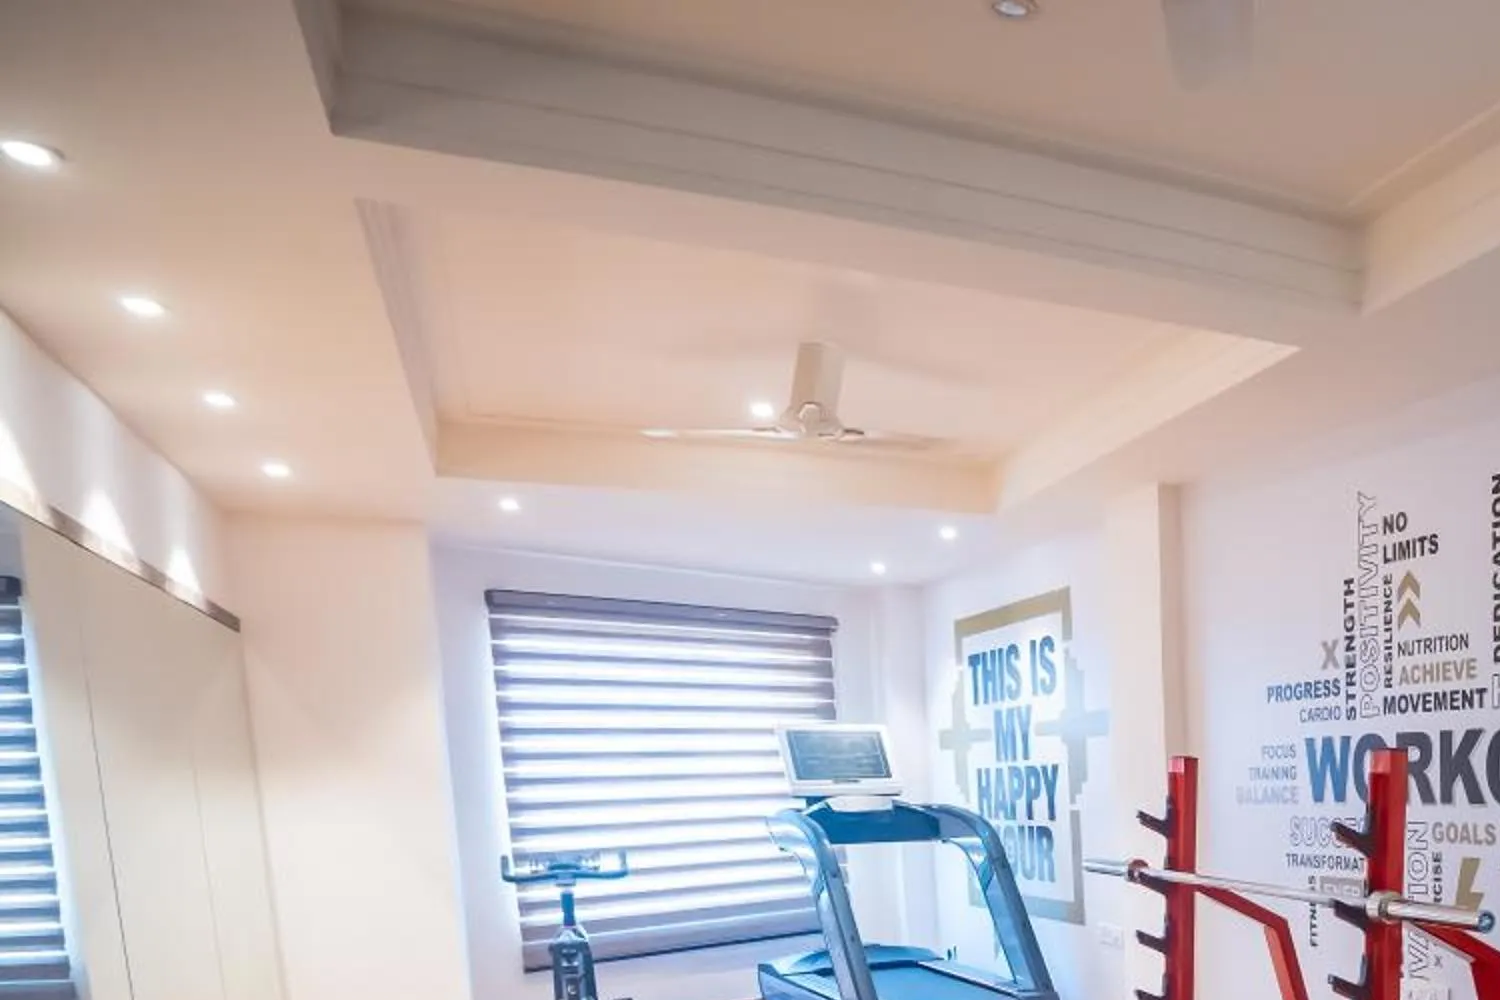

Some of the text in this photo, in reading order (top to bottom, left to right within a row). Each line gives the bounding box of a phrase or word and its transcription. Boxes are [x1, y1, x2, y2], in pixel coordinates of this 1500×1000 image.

[1383, 511, 1408, 535] NO
[1383, 533, 1439, 564] LIMITS
[1357, 490, 1381, 719] POSITIVITY
[1383, 573, 1393, 688] RESILIENCE
[1397, 633, 1469, 657] NUTRITION
[1344, 577, 1357, 720] STRENGTH
[968, 634, 1056, 706] THIS IS
[1400, 657, 1478, 686] ACHIEVE
[1267, 678, 1341, 703] PROGRESS
[1383, 687, 1488, 716] MOVEMENT
[1299, 705, 1341, 723] CARDIO
[993, 704, 1032, 762] MY
[1260, 743, 1296, 761] FOCUS
[977, 763, 1058, 821] HAPPY
[1432, 822, 1496, 846] GOALS
[1002, 824, 1055, 883] OUR
